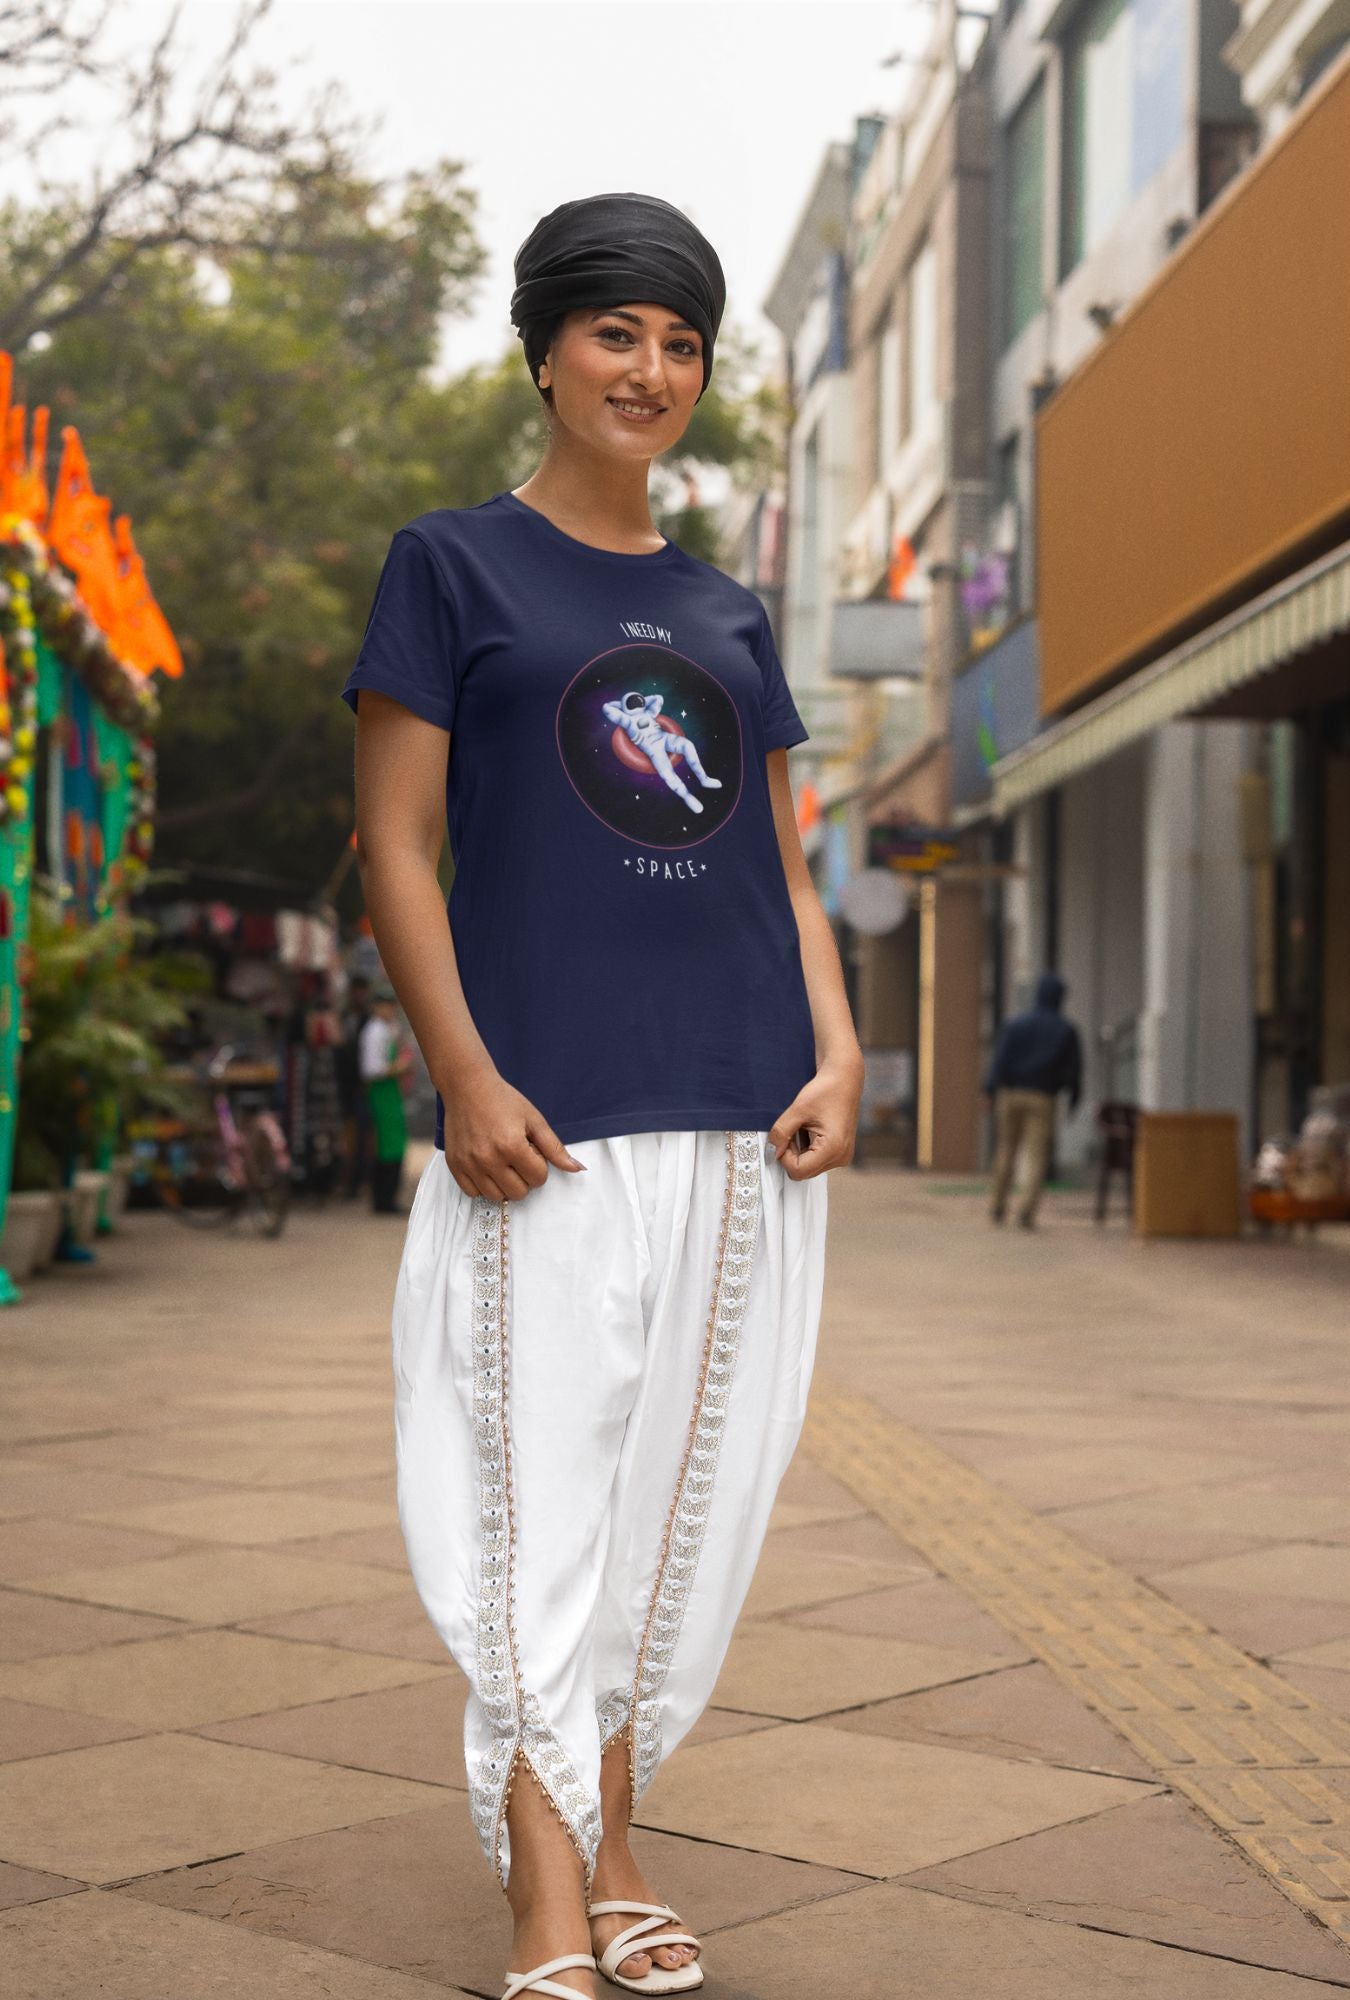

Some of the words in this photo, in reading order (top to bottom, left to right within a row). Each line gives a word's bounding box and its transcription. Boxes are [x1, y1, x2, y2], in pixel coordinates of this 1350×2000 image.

[619, 622, 630, 639] I
[626, 622, 656, 639] NEED
[656, 626, 671, 645] MY
[636, 857, 698, 879] SPACE
